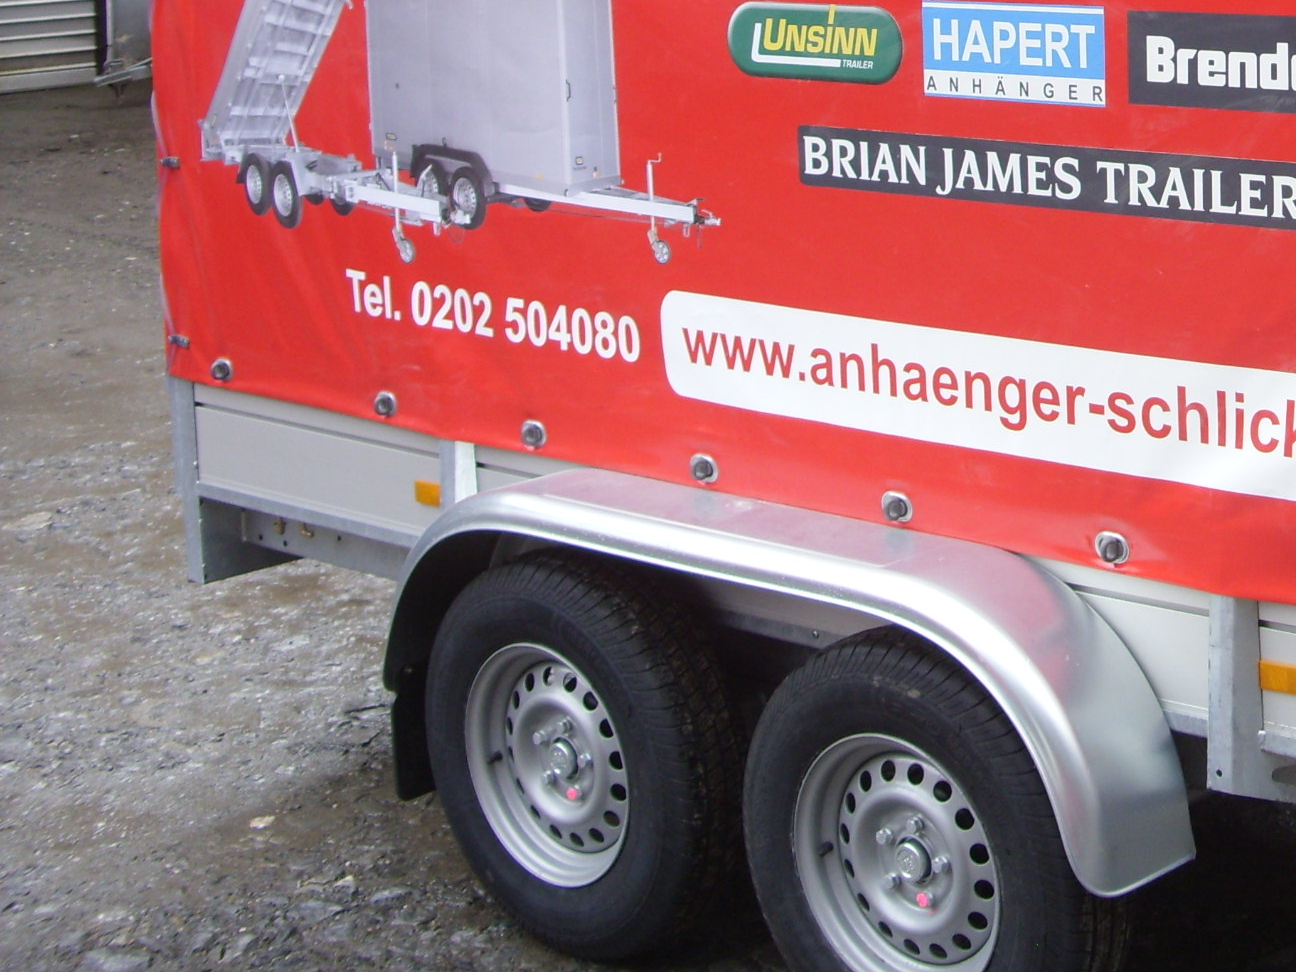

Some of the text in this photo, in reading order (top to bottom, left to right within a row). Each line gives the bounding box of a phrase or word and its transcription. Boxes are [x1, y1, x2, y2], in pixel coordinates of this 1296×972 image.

[763, 3, 878, 57] UNSINN
[932, 18, 1096, 69] HAPERT
[842, 59, 874, 70] TRAILER
[926, 74, 1105, 104] ANHÄNGER
[803, 135, 928, 186] BRIAN
[935, 148, 1081, 200] JAMES
[345, 268, 641, 363] Tel. 0202 504080
